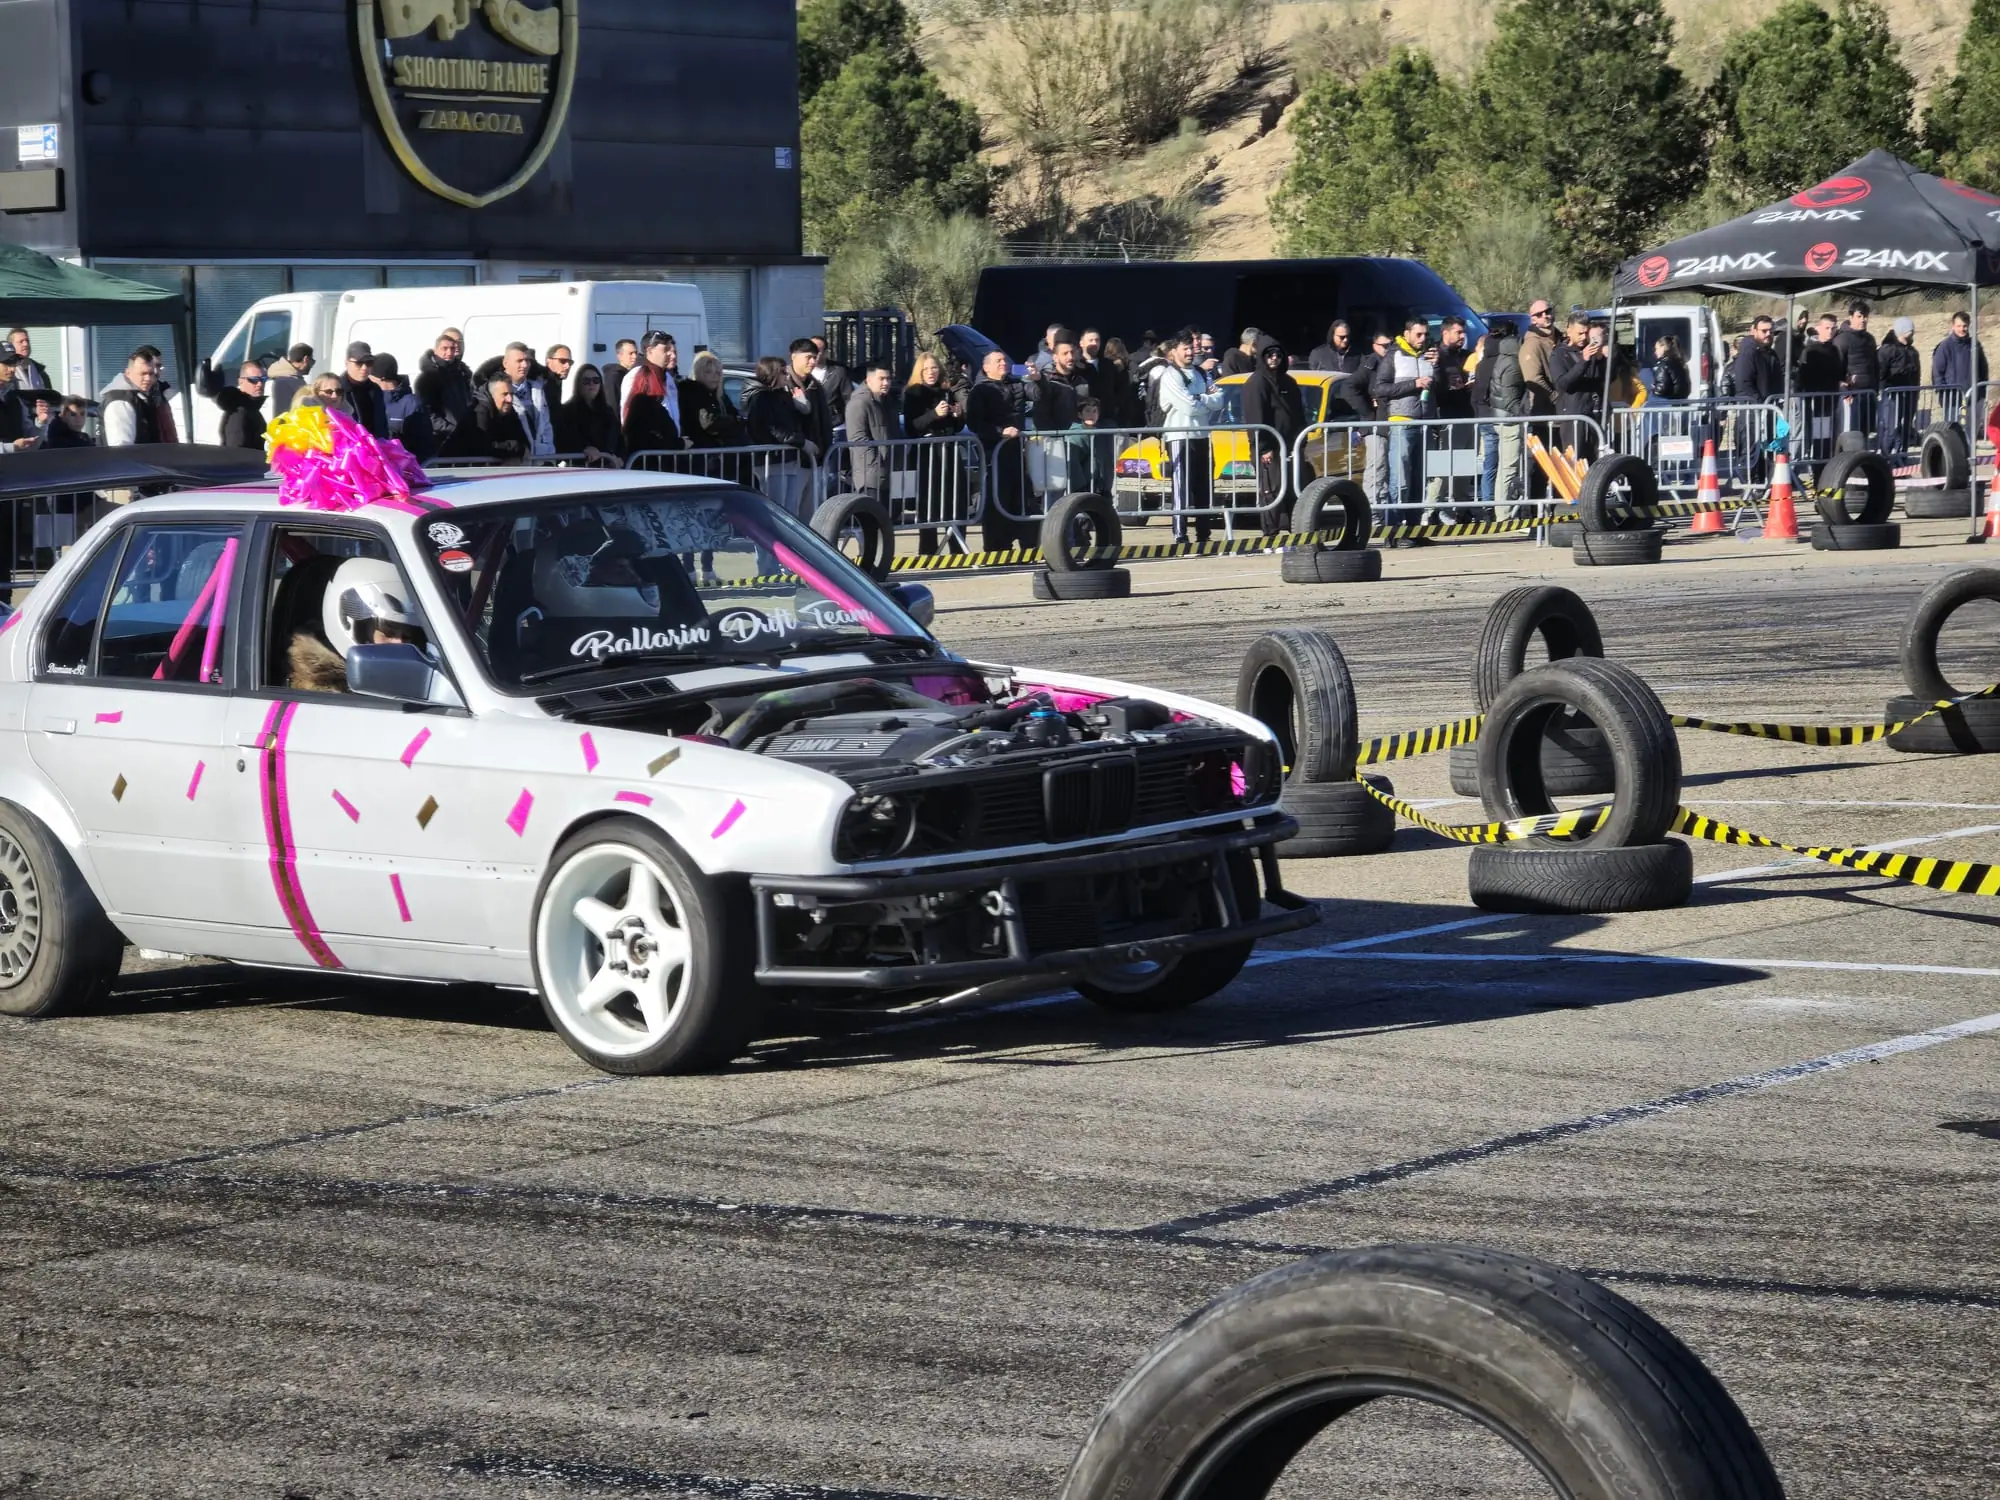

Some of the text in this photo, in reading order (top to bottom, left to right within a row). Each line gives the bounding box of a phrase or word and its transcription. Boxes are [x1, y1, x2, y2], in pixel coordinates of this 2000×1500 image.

[400, 55, 550, 94] SHOOTING RANGE
[419, 110, 524, 134] ZARAGOZA
[1752, 209, 1865, 224] 24MX
[1674, 251, 1776, 278] 24MX
[1842, 249, 1951, 272] 24MX
[570, 600, 874, 659] Ballarin Drift Team
[785, 739, 841, 752] BMW
